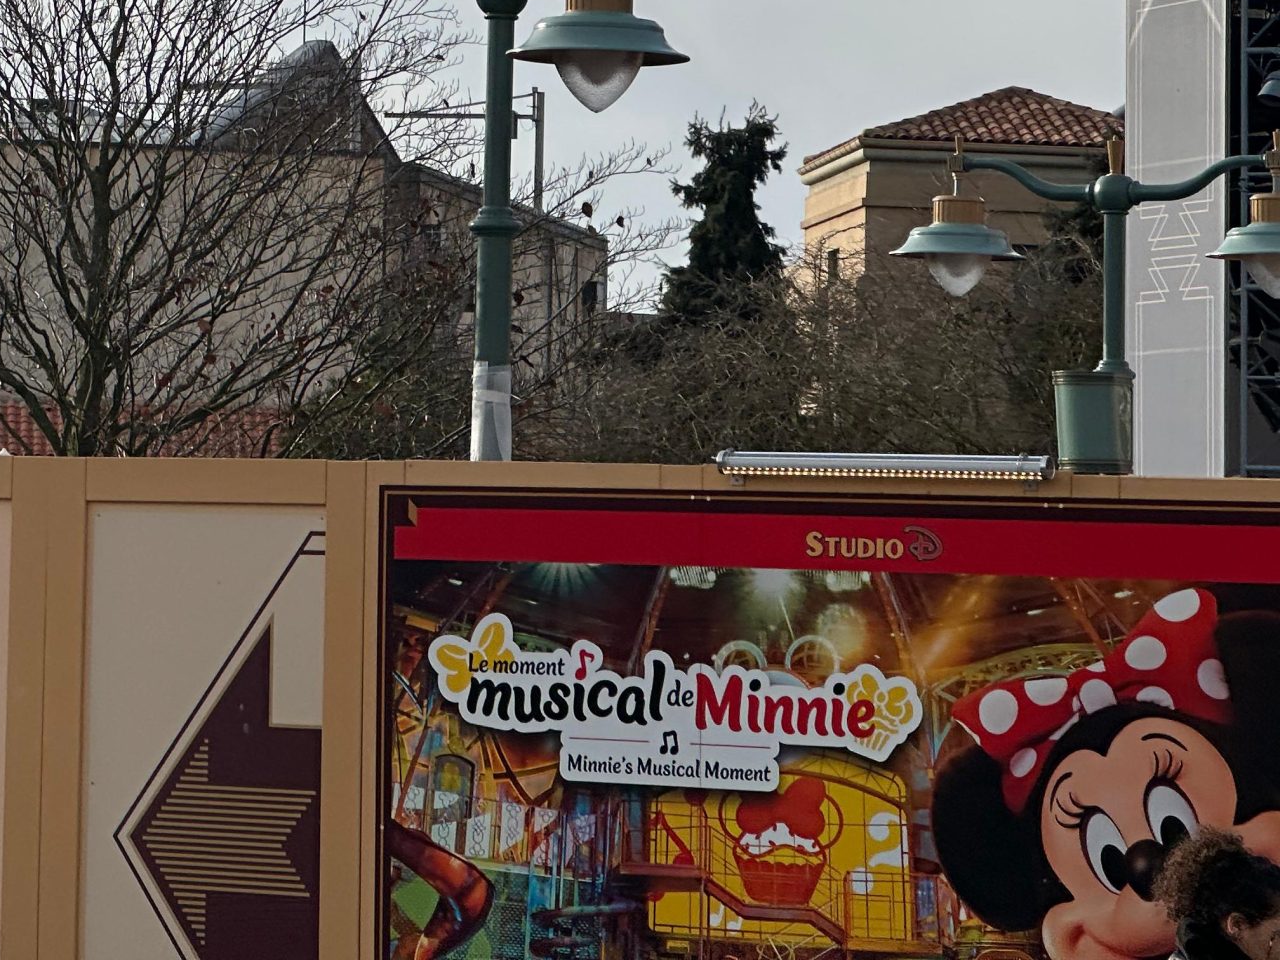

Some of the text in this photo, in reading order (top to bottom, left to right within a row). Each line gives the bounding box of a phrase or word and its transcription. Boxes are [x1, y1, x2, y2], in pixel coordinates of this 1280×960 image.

[805, 531, 904, 560] STUDIO
[468, 652, 565, 676] Le moment
[467, 659, 876, 738] musical de Minnie
[567, 753, 771, 782] Minnie's Musical Moment
